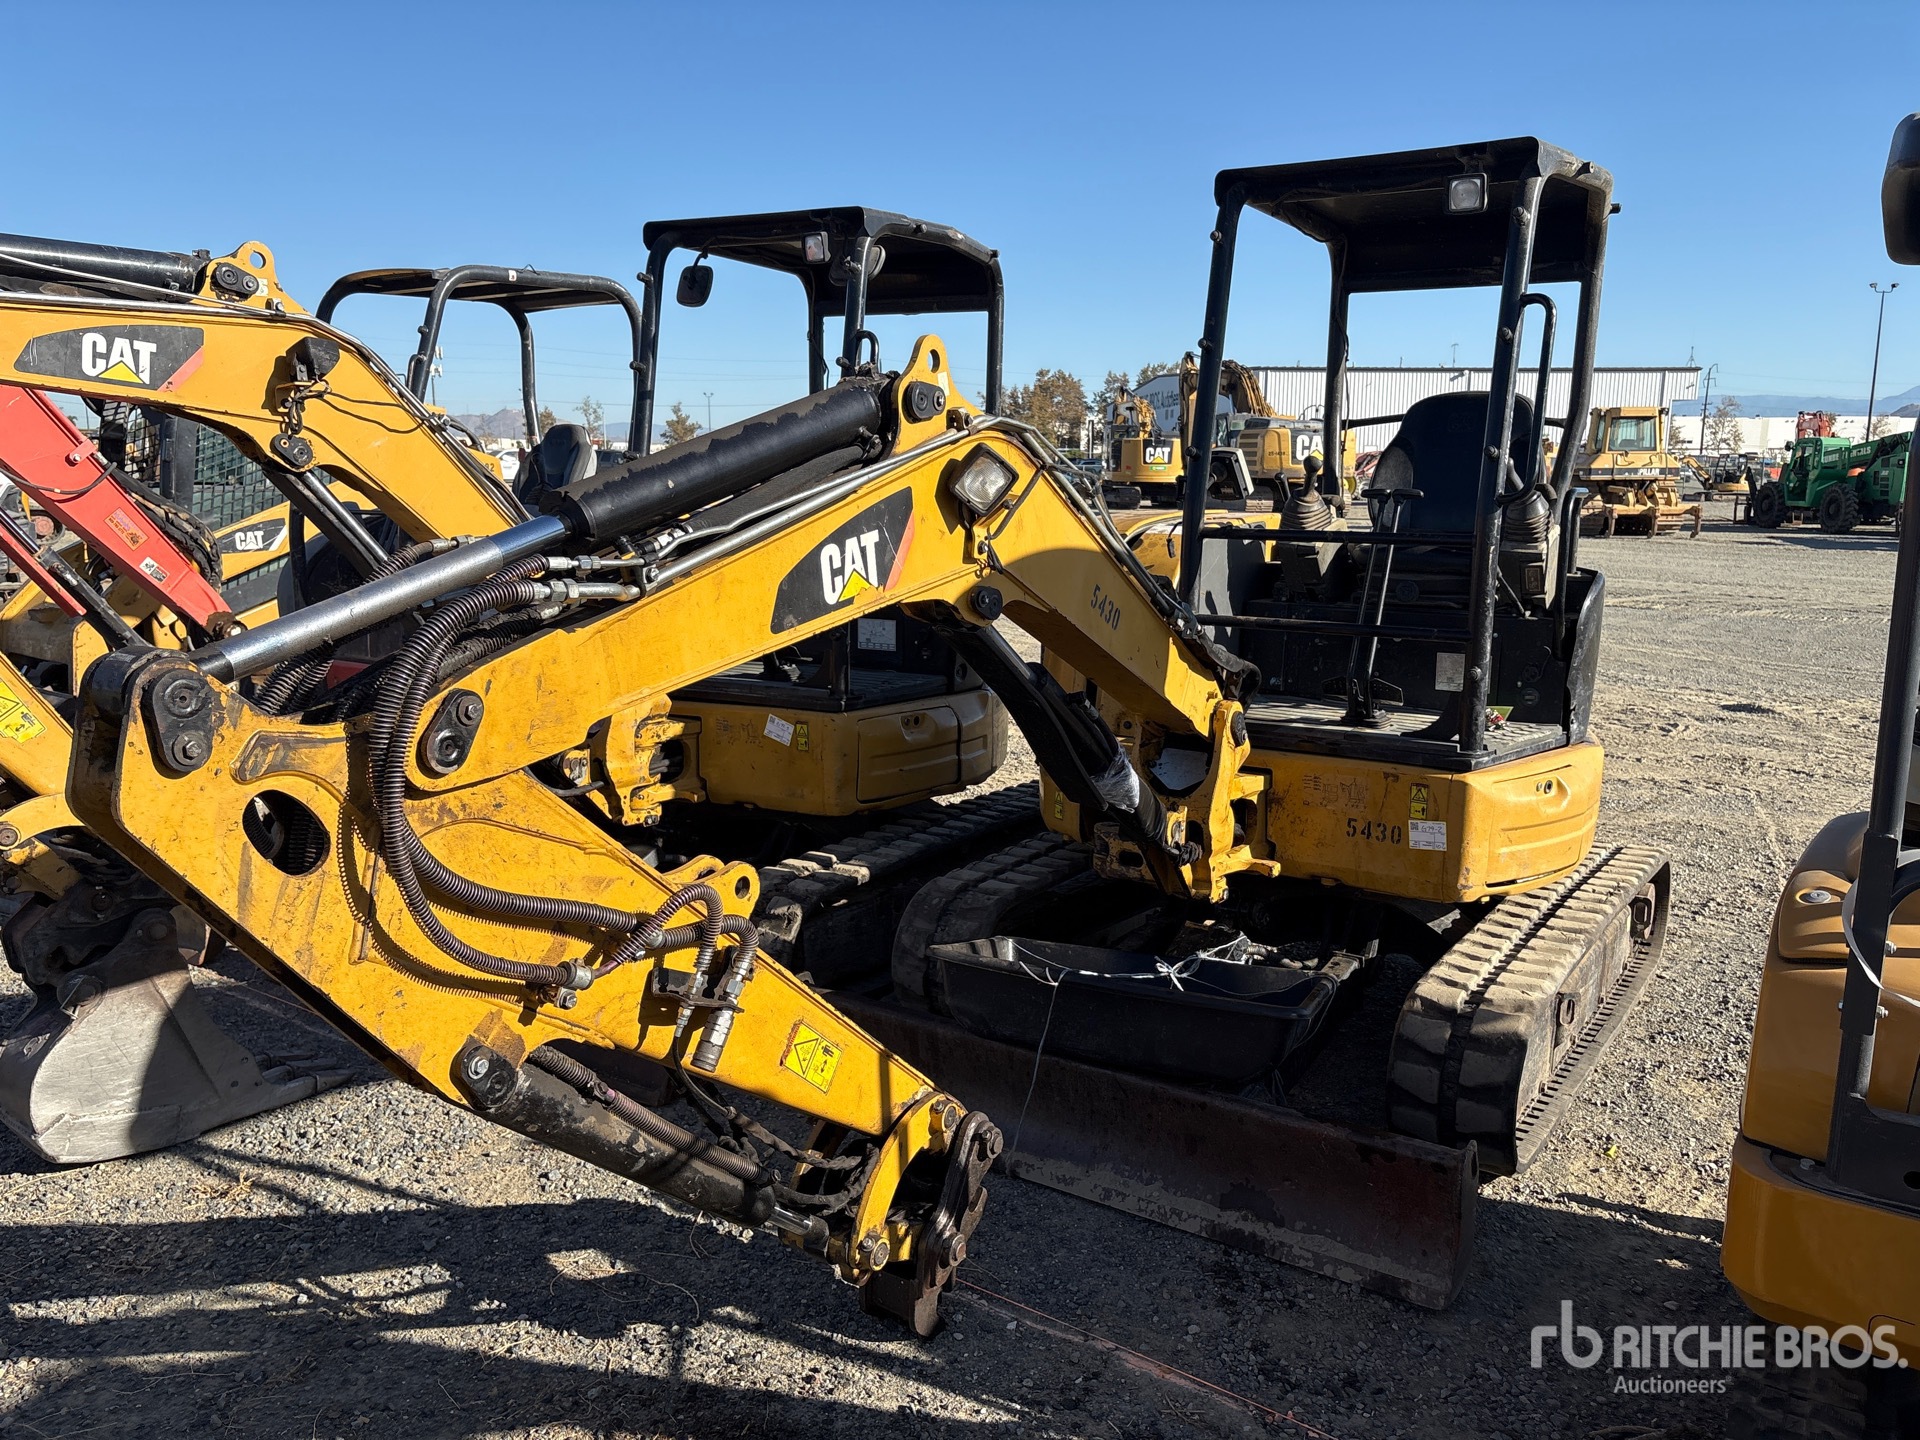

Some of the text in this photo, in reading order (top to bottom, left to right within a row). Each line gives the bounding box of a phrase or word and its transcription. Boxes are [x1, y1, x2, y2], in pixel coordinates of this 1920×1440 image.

[82, 333, 157, 385] CAT
[1145, 447, 1171, 463] CAT
[1296, 434, 1324, 461] CA
[235, 530, 264, 550] CAT
[821, 529, 880, 605] CAT
[1091, 583, 1120, 630] 5430
[1346, 817, 1402, 845] 5430
